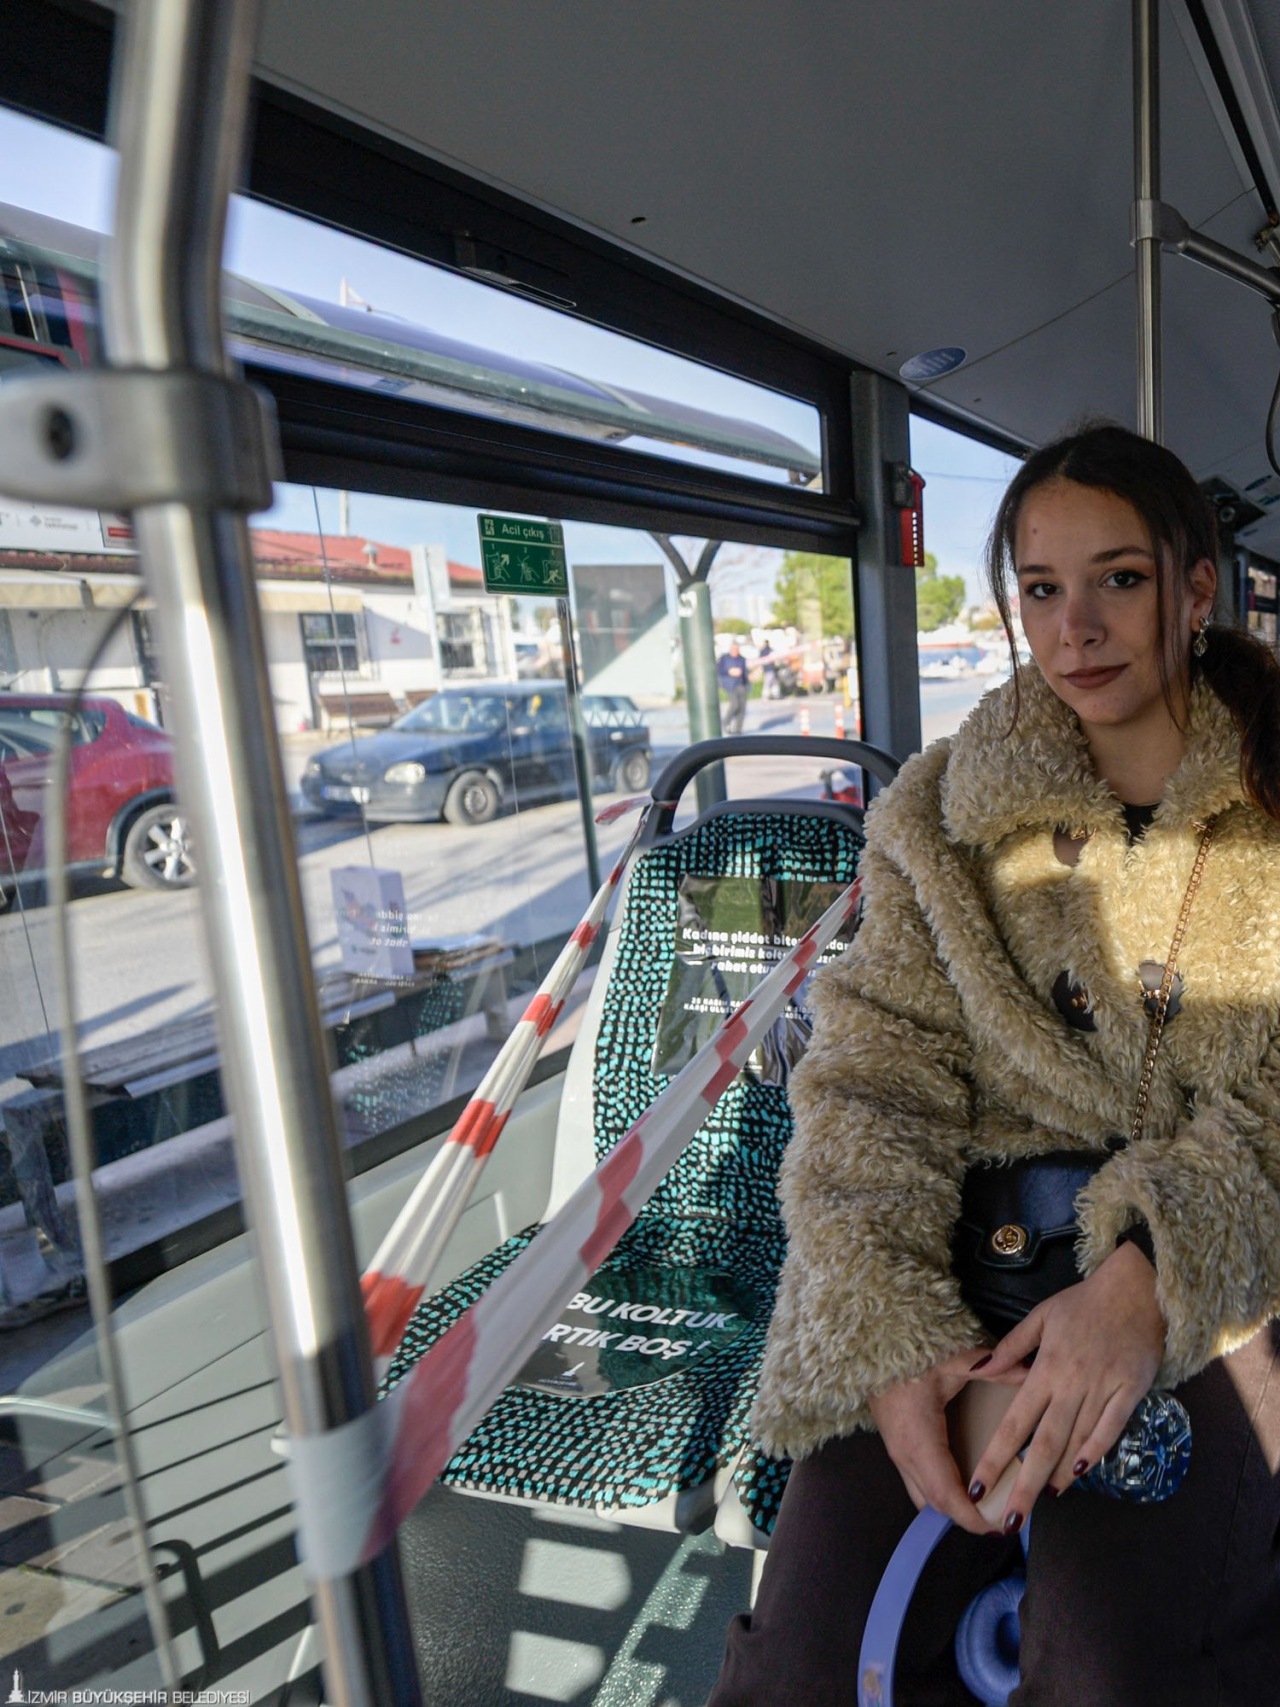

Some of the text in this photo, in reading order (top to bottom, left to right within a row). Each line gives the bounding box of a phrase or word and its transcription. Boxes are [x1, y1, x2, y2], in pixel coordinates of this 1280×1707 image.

[501, 523, 545, 541] Acil çıkış
[682, 928, 729, 942] Kadına
[730, 930, 770, 945] şiddet
[566, 1292, 739, 1329] BU KOLTUK
[541, 1323, 624, 1350] RTIK
